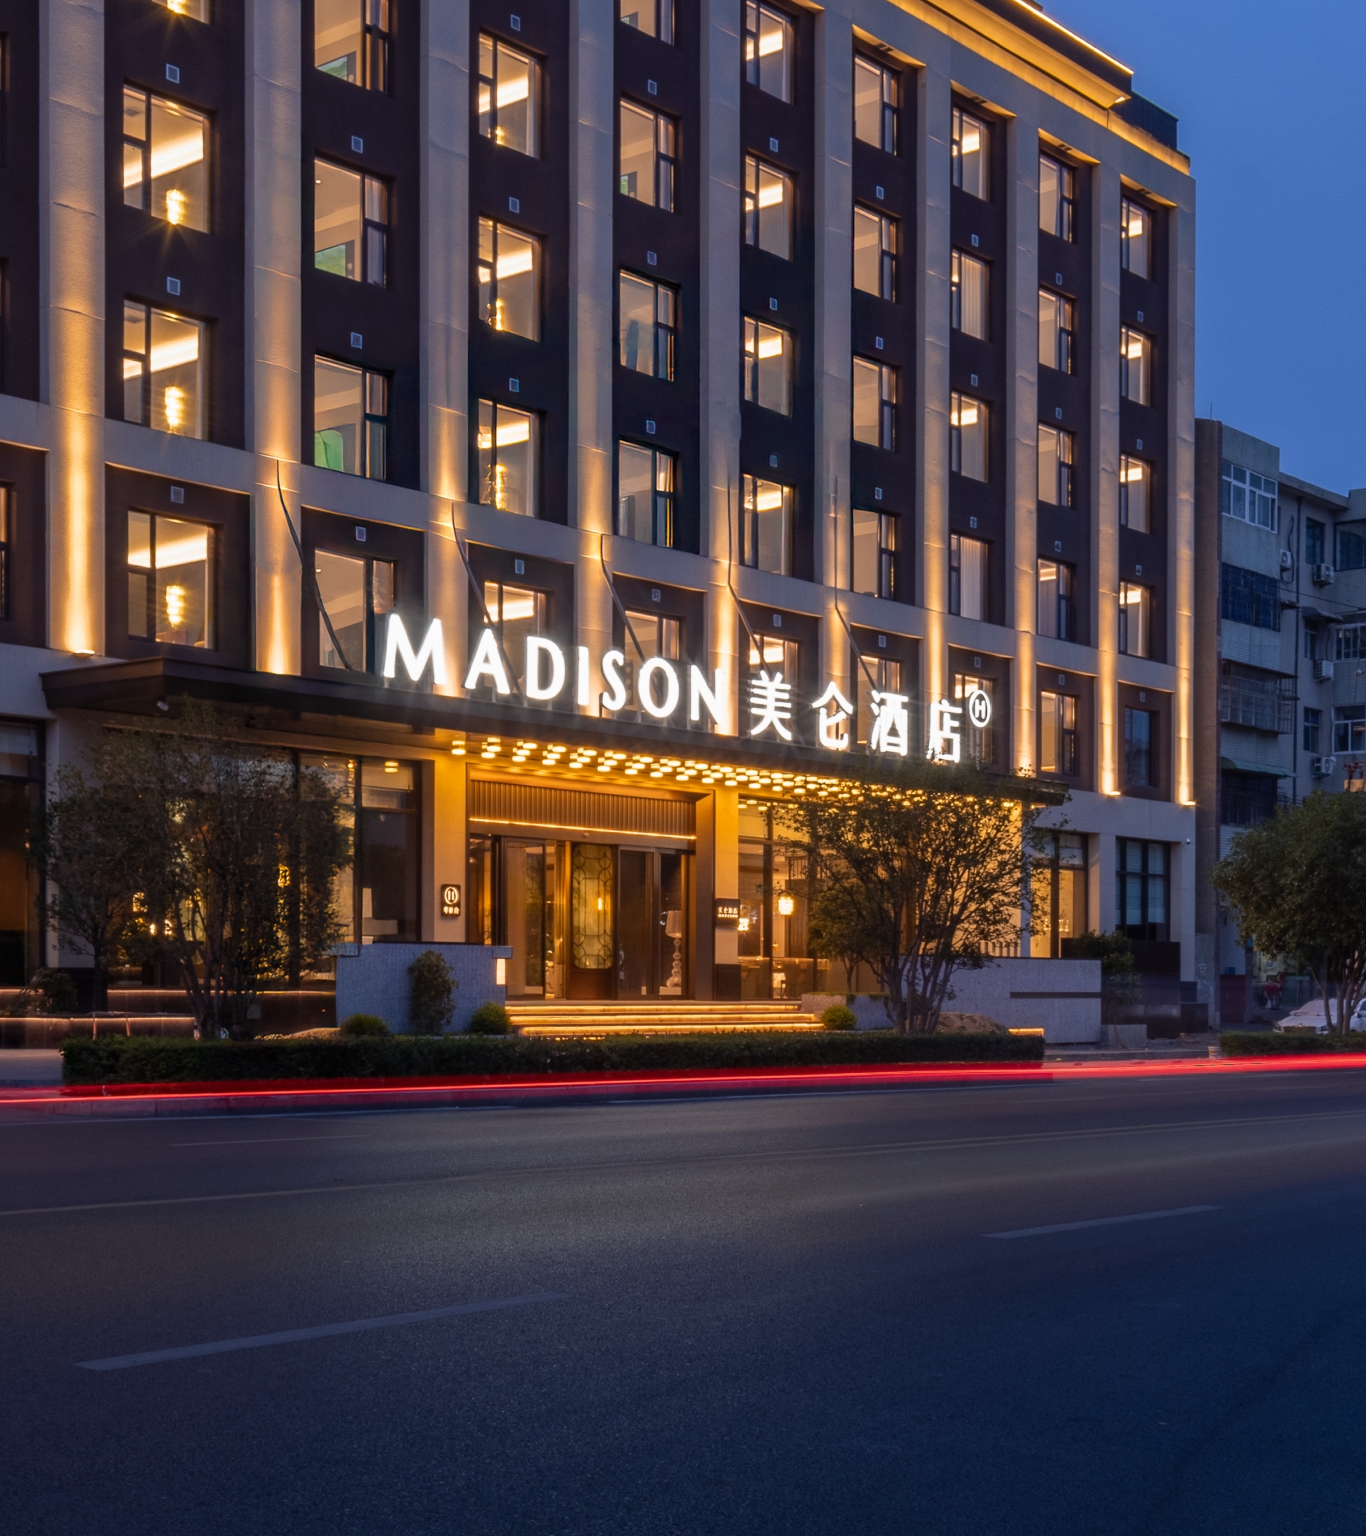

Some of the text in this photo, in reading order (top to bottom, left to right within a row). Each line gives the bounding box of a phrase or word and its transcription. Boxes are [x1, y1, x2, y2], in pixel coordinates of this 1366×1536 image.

[382, 612, 725, 726] MADISON
[748, 670, 963, 764] 美仑酒店
